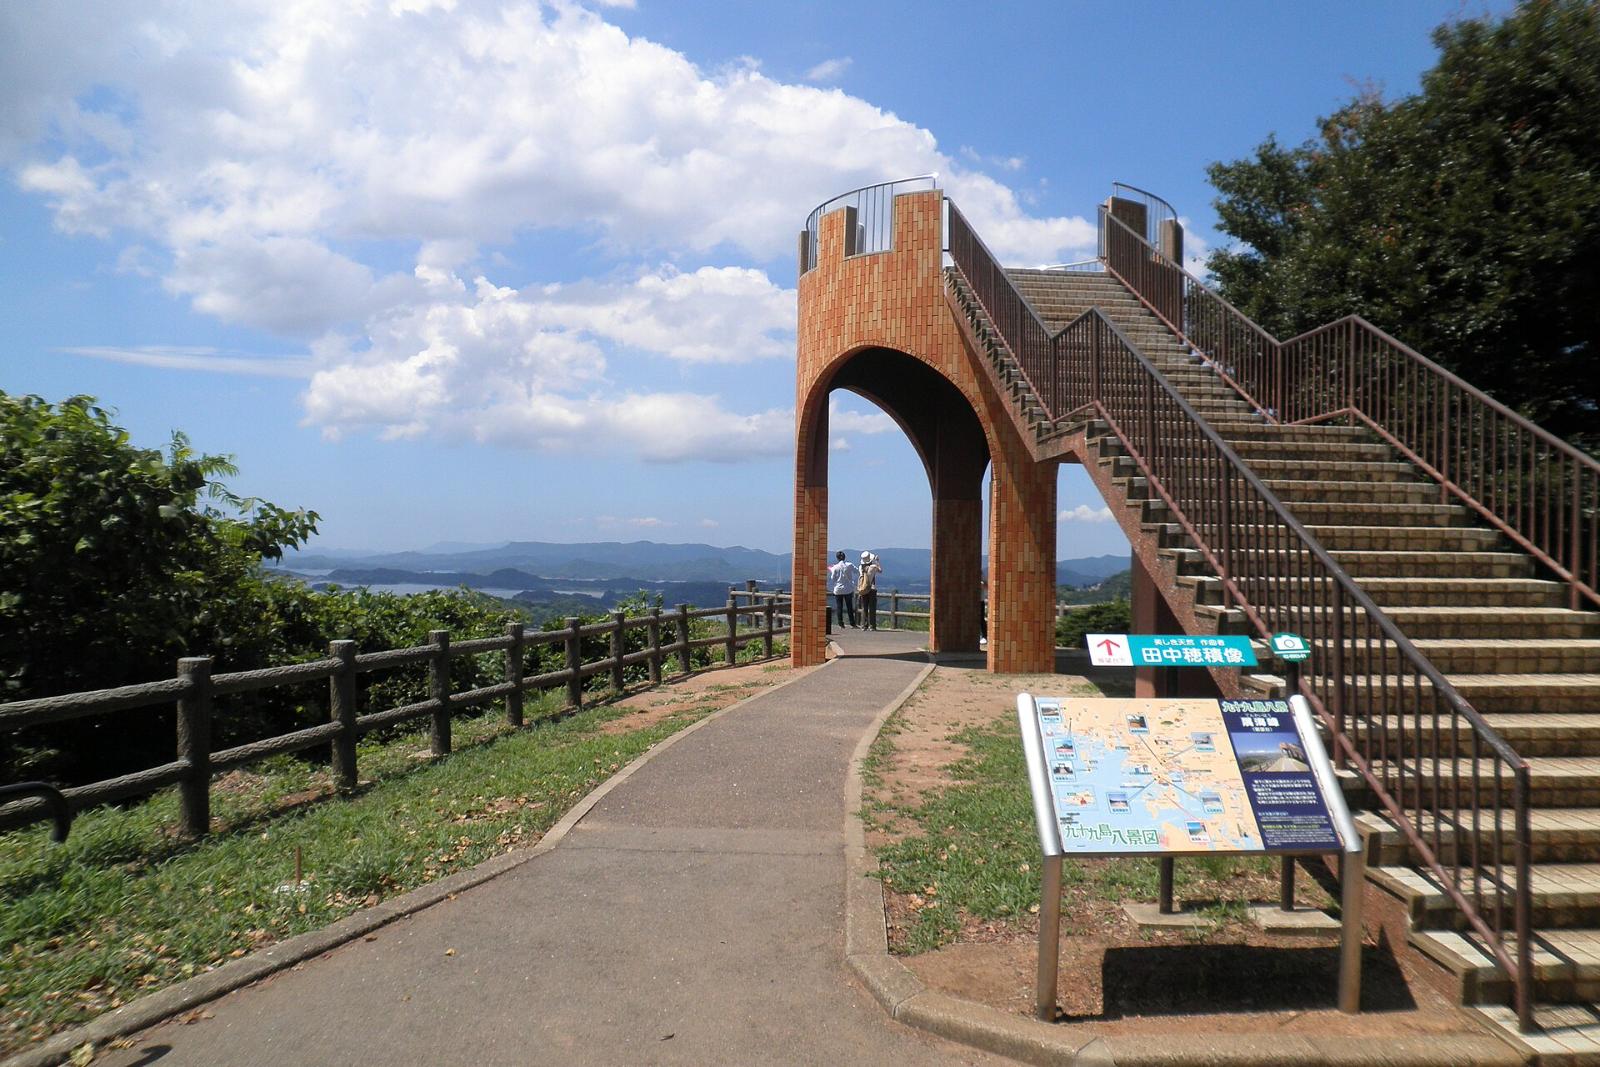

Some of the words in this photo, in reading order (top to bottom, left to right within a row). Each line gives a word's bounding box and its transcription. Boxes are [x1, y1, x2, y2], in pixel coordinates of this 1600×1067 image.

[1141, 647, 1246, 663] 田中穂積像
[1221, 700, 1289, 713] 九十九島八景
[1064, 822, 1160, 846] 九十九島八景図
